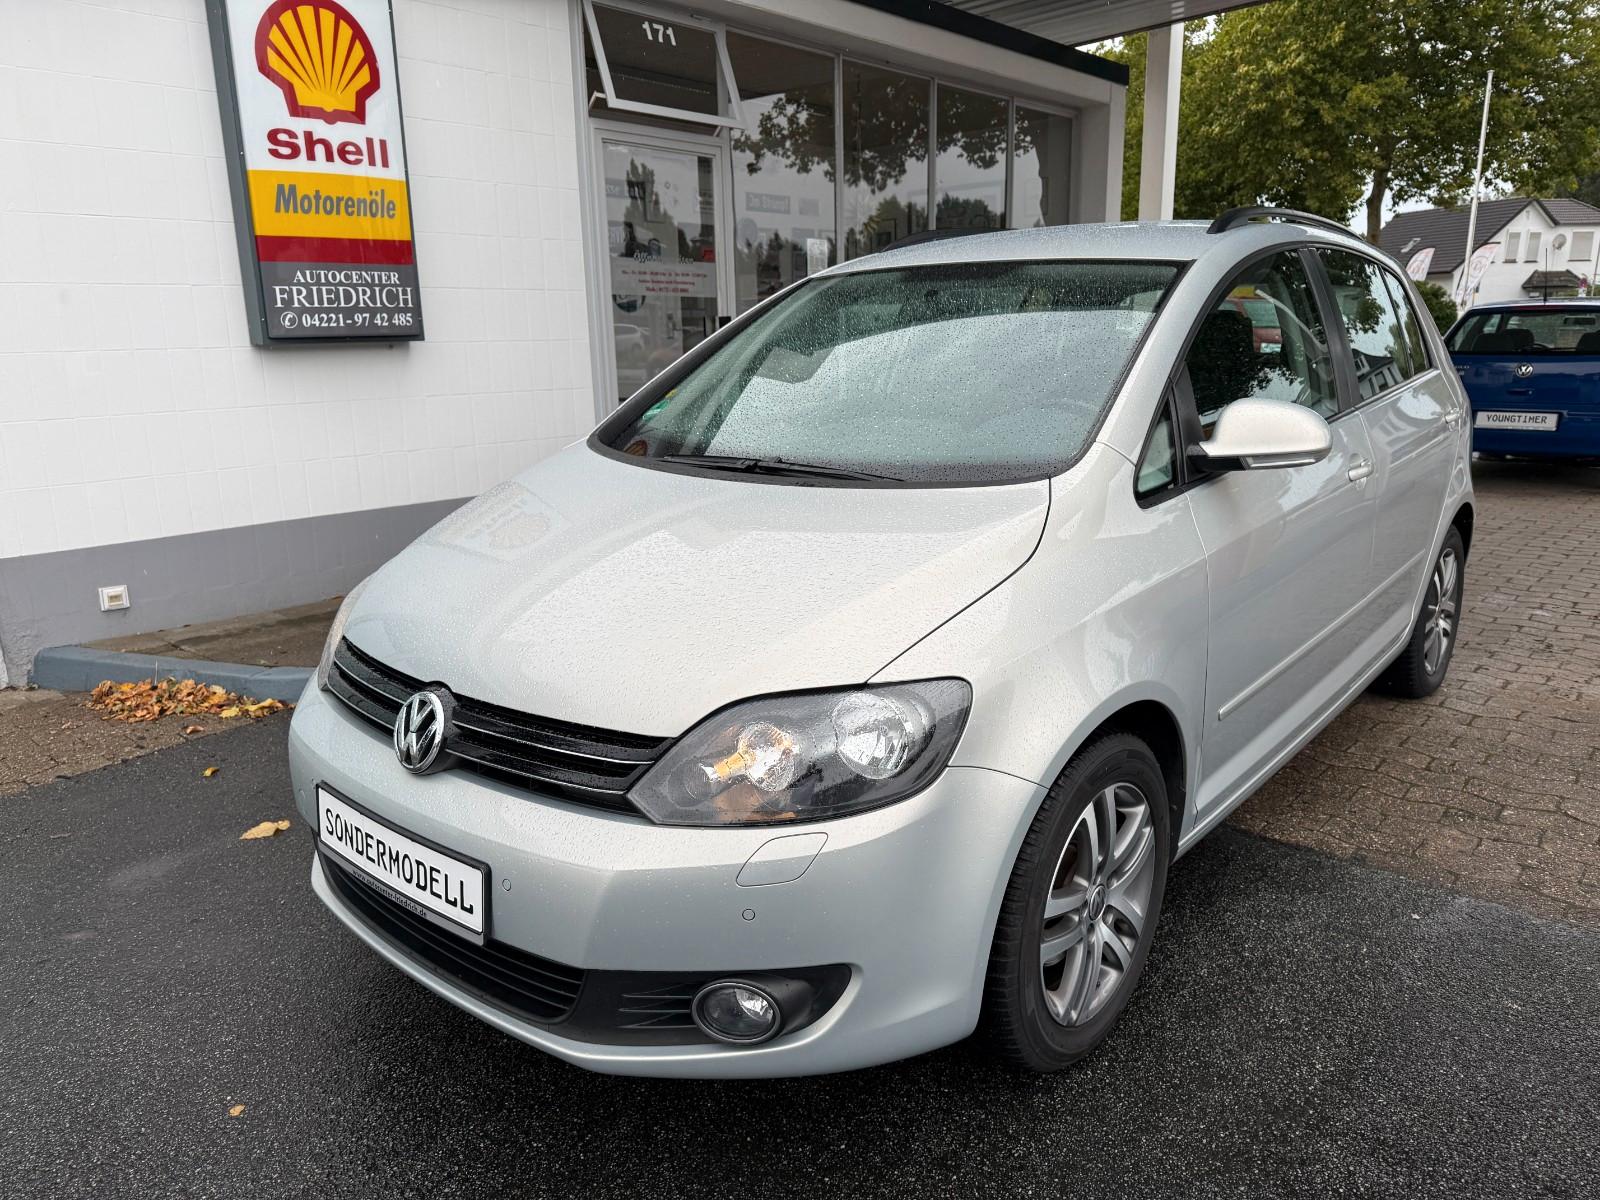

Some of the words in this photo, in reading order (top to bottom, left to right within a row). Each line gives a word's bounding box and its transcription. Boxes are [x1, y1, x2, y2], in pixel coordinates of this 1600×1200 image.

[642, 21, 677, 46] 171
[266, 128, 390, 169] Shell
[274, 183, 397, 219] Motorenöle
[293, 270, 400, 284] AUTOCENTER
[272, 285, 414, 308] FRIEDRICH
[373, 313, 389, 327] 42
[392, 313, 413, 327] 485
[1486, 413, 1548, 425] YOUNGTIMER
[325, 807, 474, 915] SONDERMODELL
